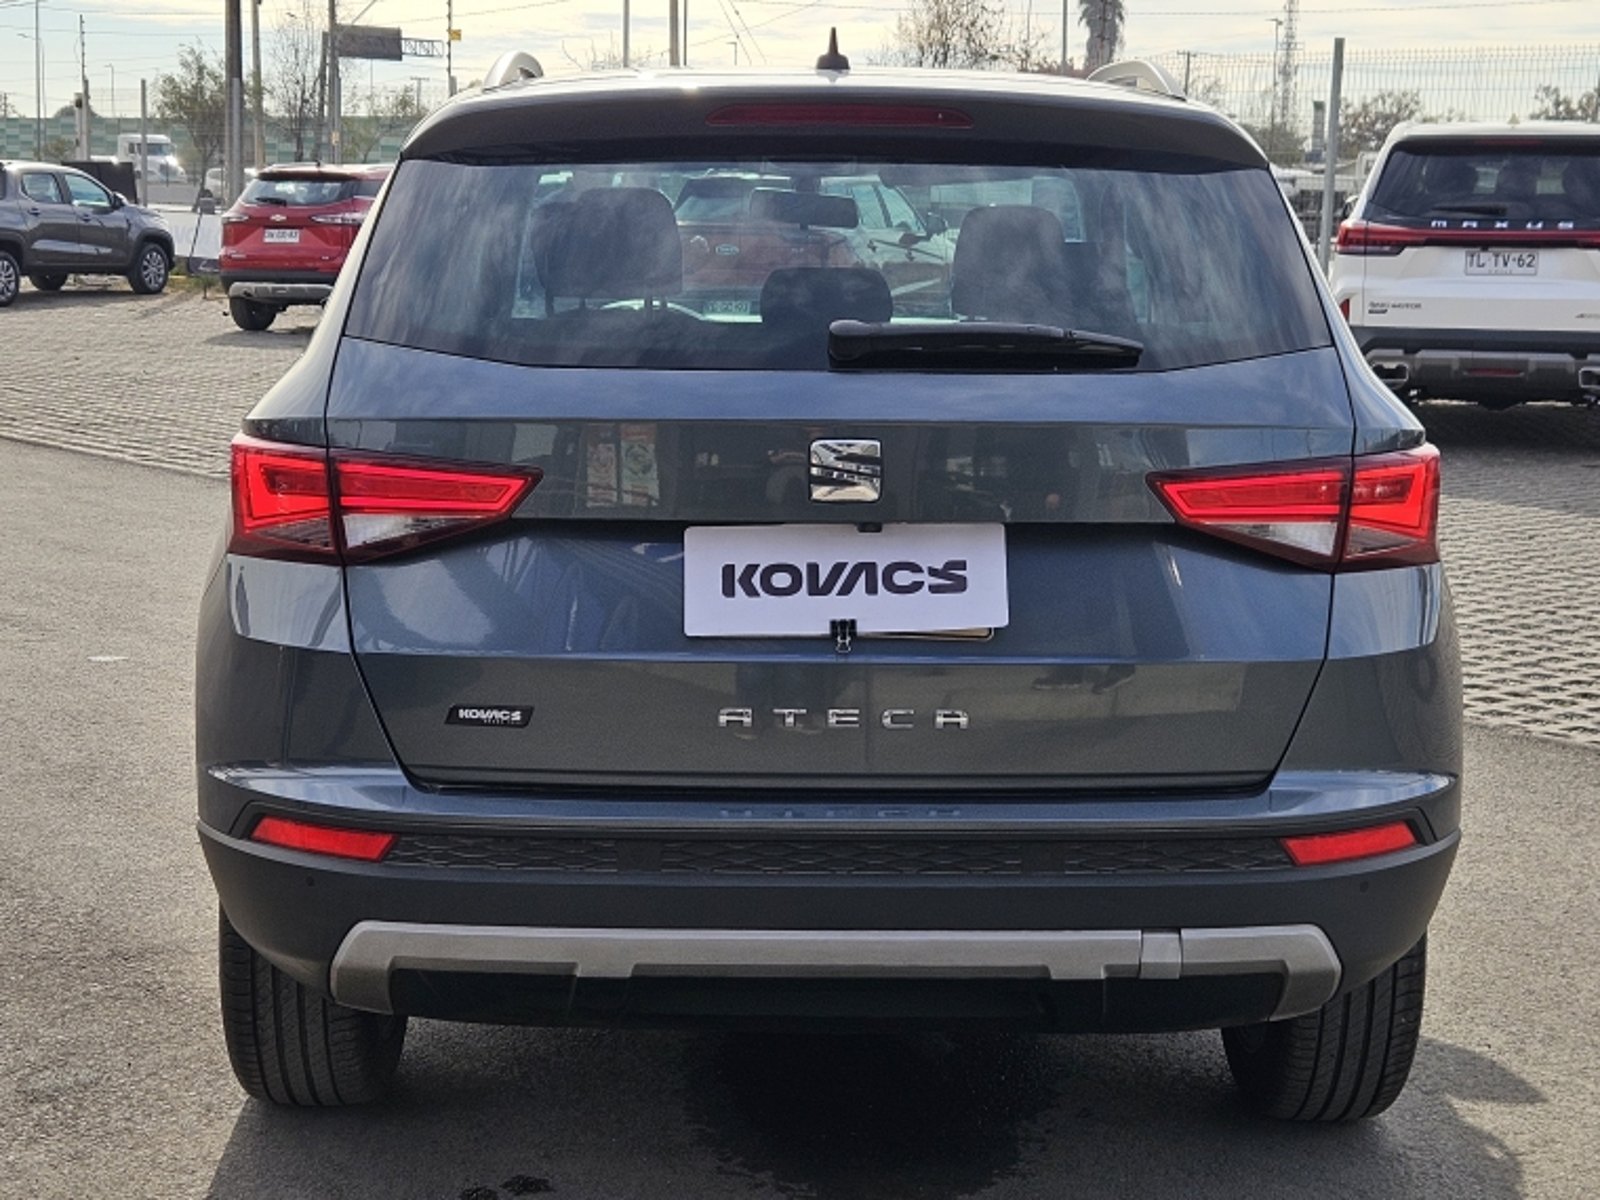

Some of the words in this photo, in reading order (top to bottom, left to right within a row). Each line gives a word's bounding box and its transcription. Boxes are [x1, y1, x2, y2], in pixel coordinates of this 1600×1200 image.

[1431, 220, 1574, 229] MAXUS
[721, 559, 968, 598] KOVACS
[458, 708, 522, 721] KOVACS
[718, 708, 969, 729] ATECA
